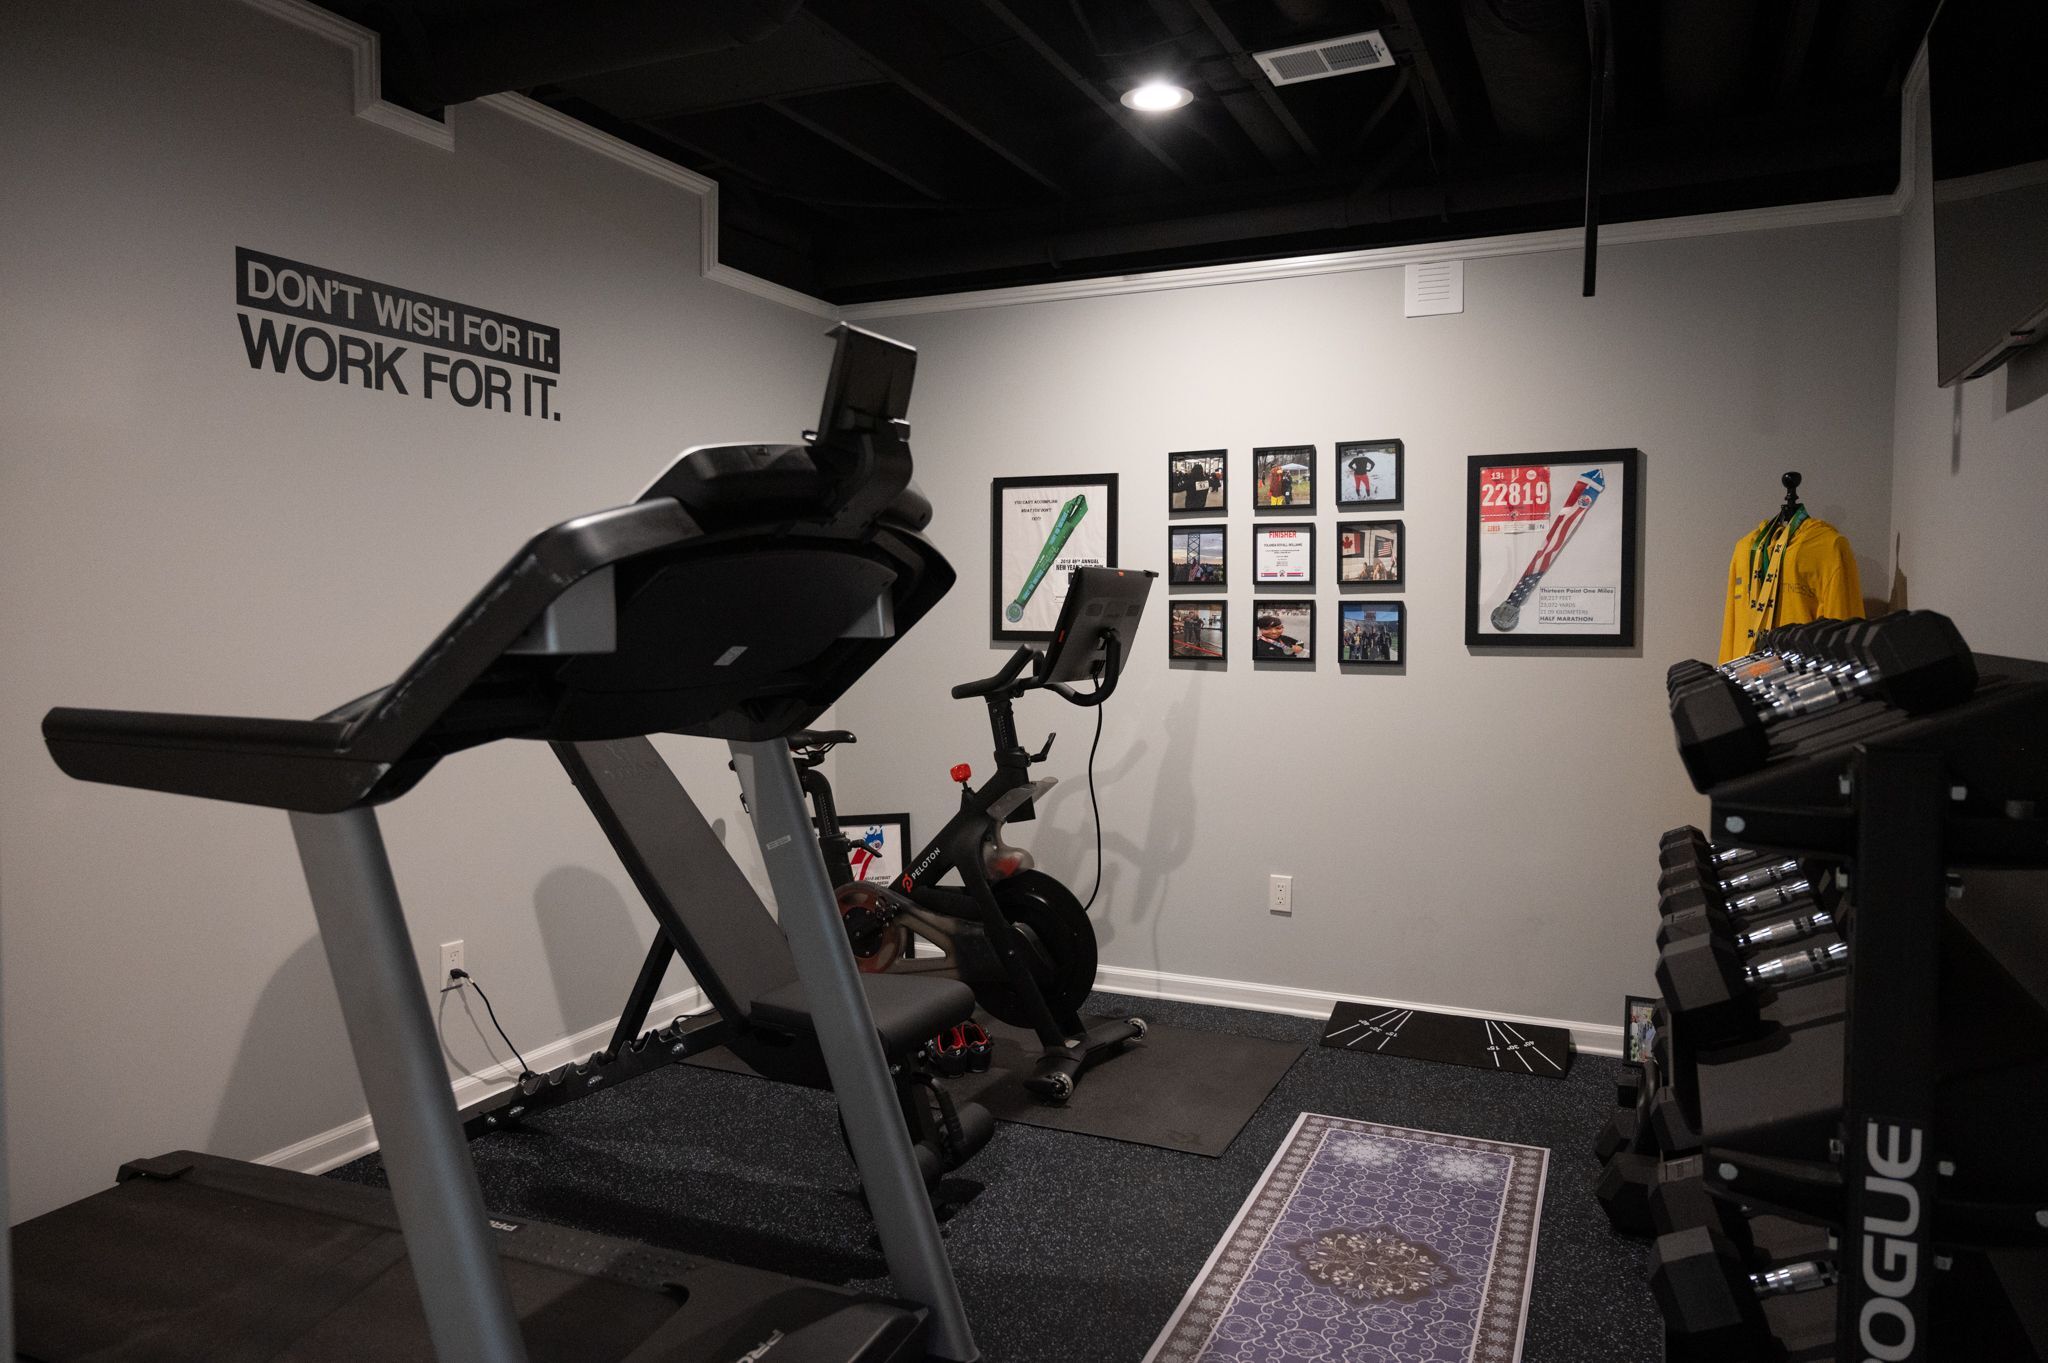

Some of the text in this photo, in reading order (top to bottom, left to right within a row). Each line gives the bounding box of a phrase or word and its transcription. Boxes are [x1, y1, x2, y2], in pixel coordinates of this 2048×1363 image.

[247, 260, 553, 364] DON'T WISH FOR IT.
[237, 313, 561, 421] WORK FOR IT.
[1482, 481, 1548, 506] 22819
[1269, 530, 1296, 538] FINISHER
[911, 847, 941, 880] PELOTON
[1858, 1122, 1923, 1363] OGUE
